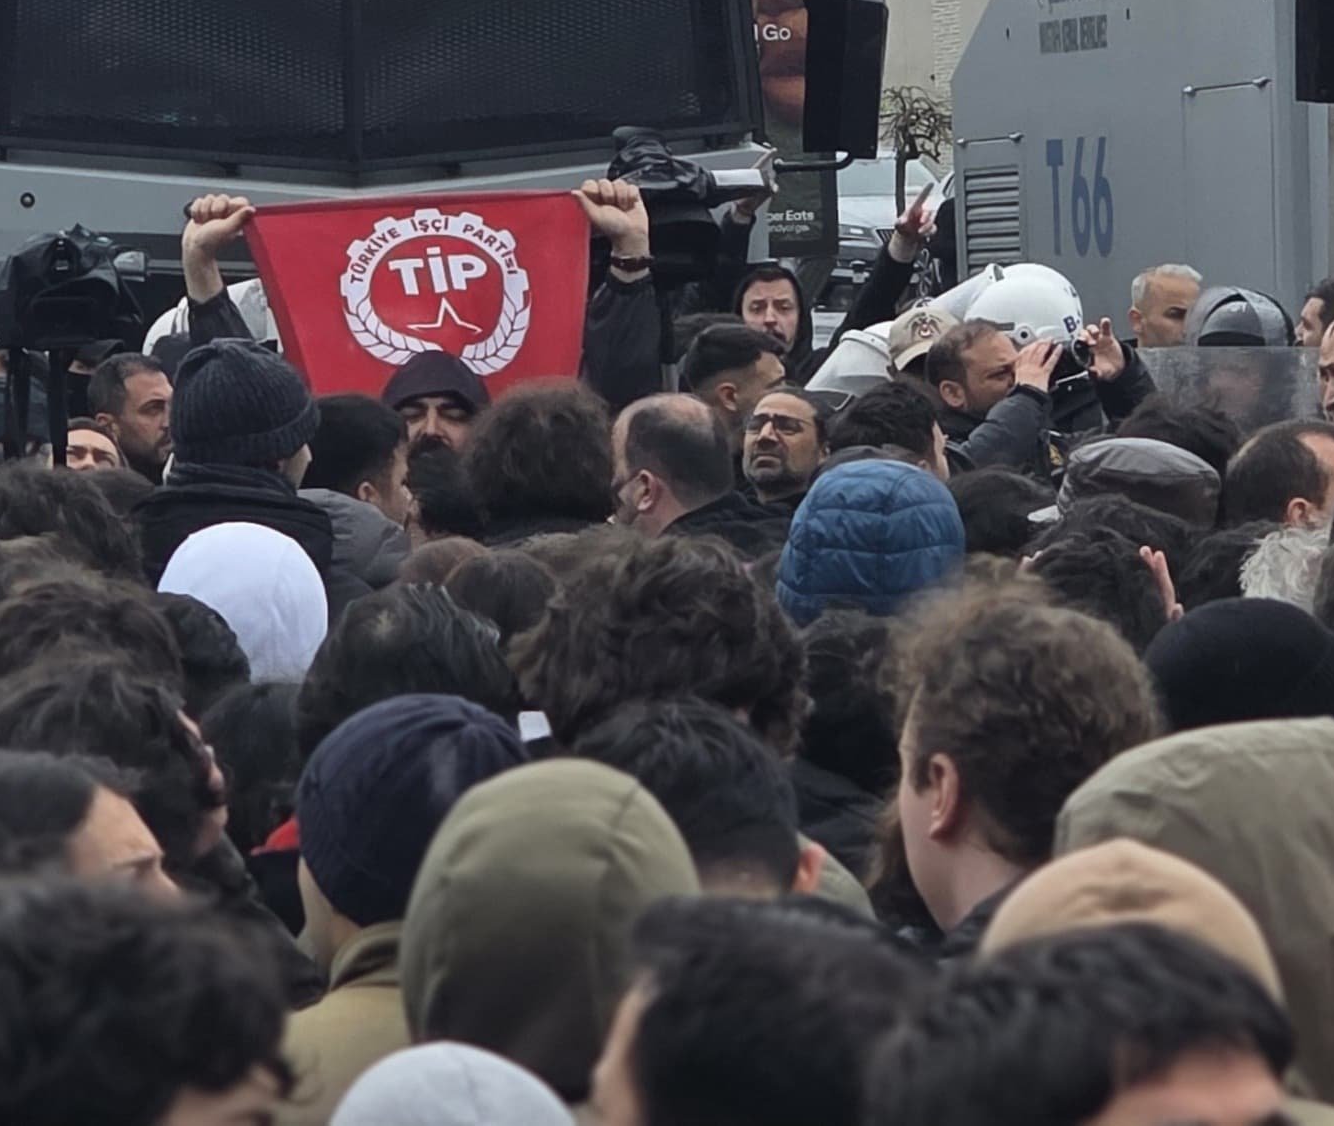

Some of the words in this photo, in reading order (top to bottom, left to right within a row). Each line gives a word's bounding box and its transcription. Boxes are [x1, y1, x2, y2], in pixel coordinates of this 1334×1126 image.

[762, 23, 792, 42] Go
[785, 209, 815, 222] Eats
[1045, 138, 1064, 257] T
[1071, 135, 1114, 259] 66
[350, 227, 401, 285] TÜRKİYE
[410, 217, 450, 233] İŞÇİ
[462, 223, 519, 276] PARTİSİ
[388, 245, 488, 296] TİP
